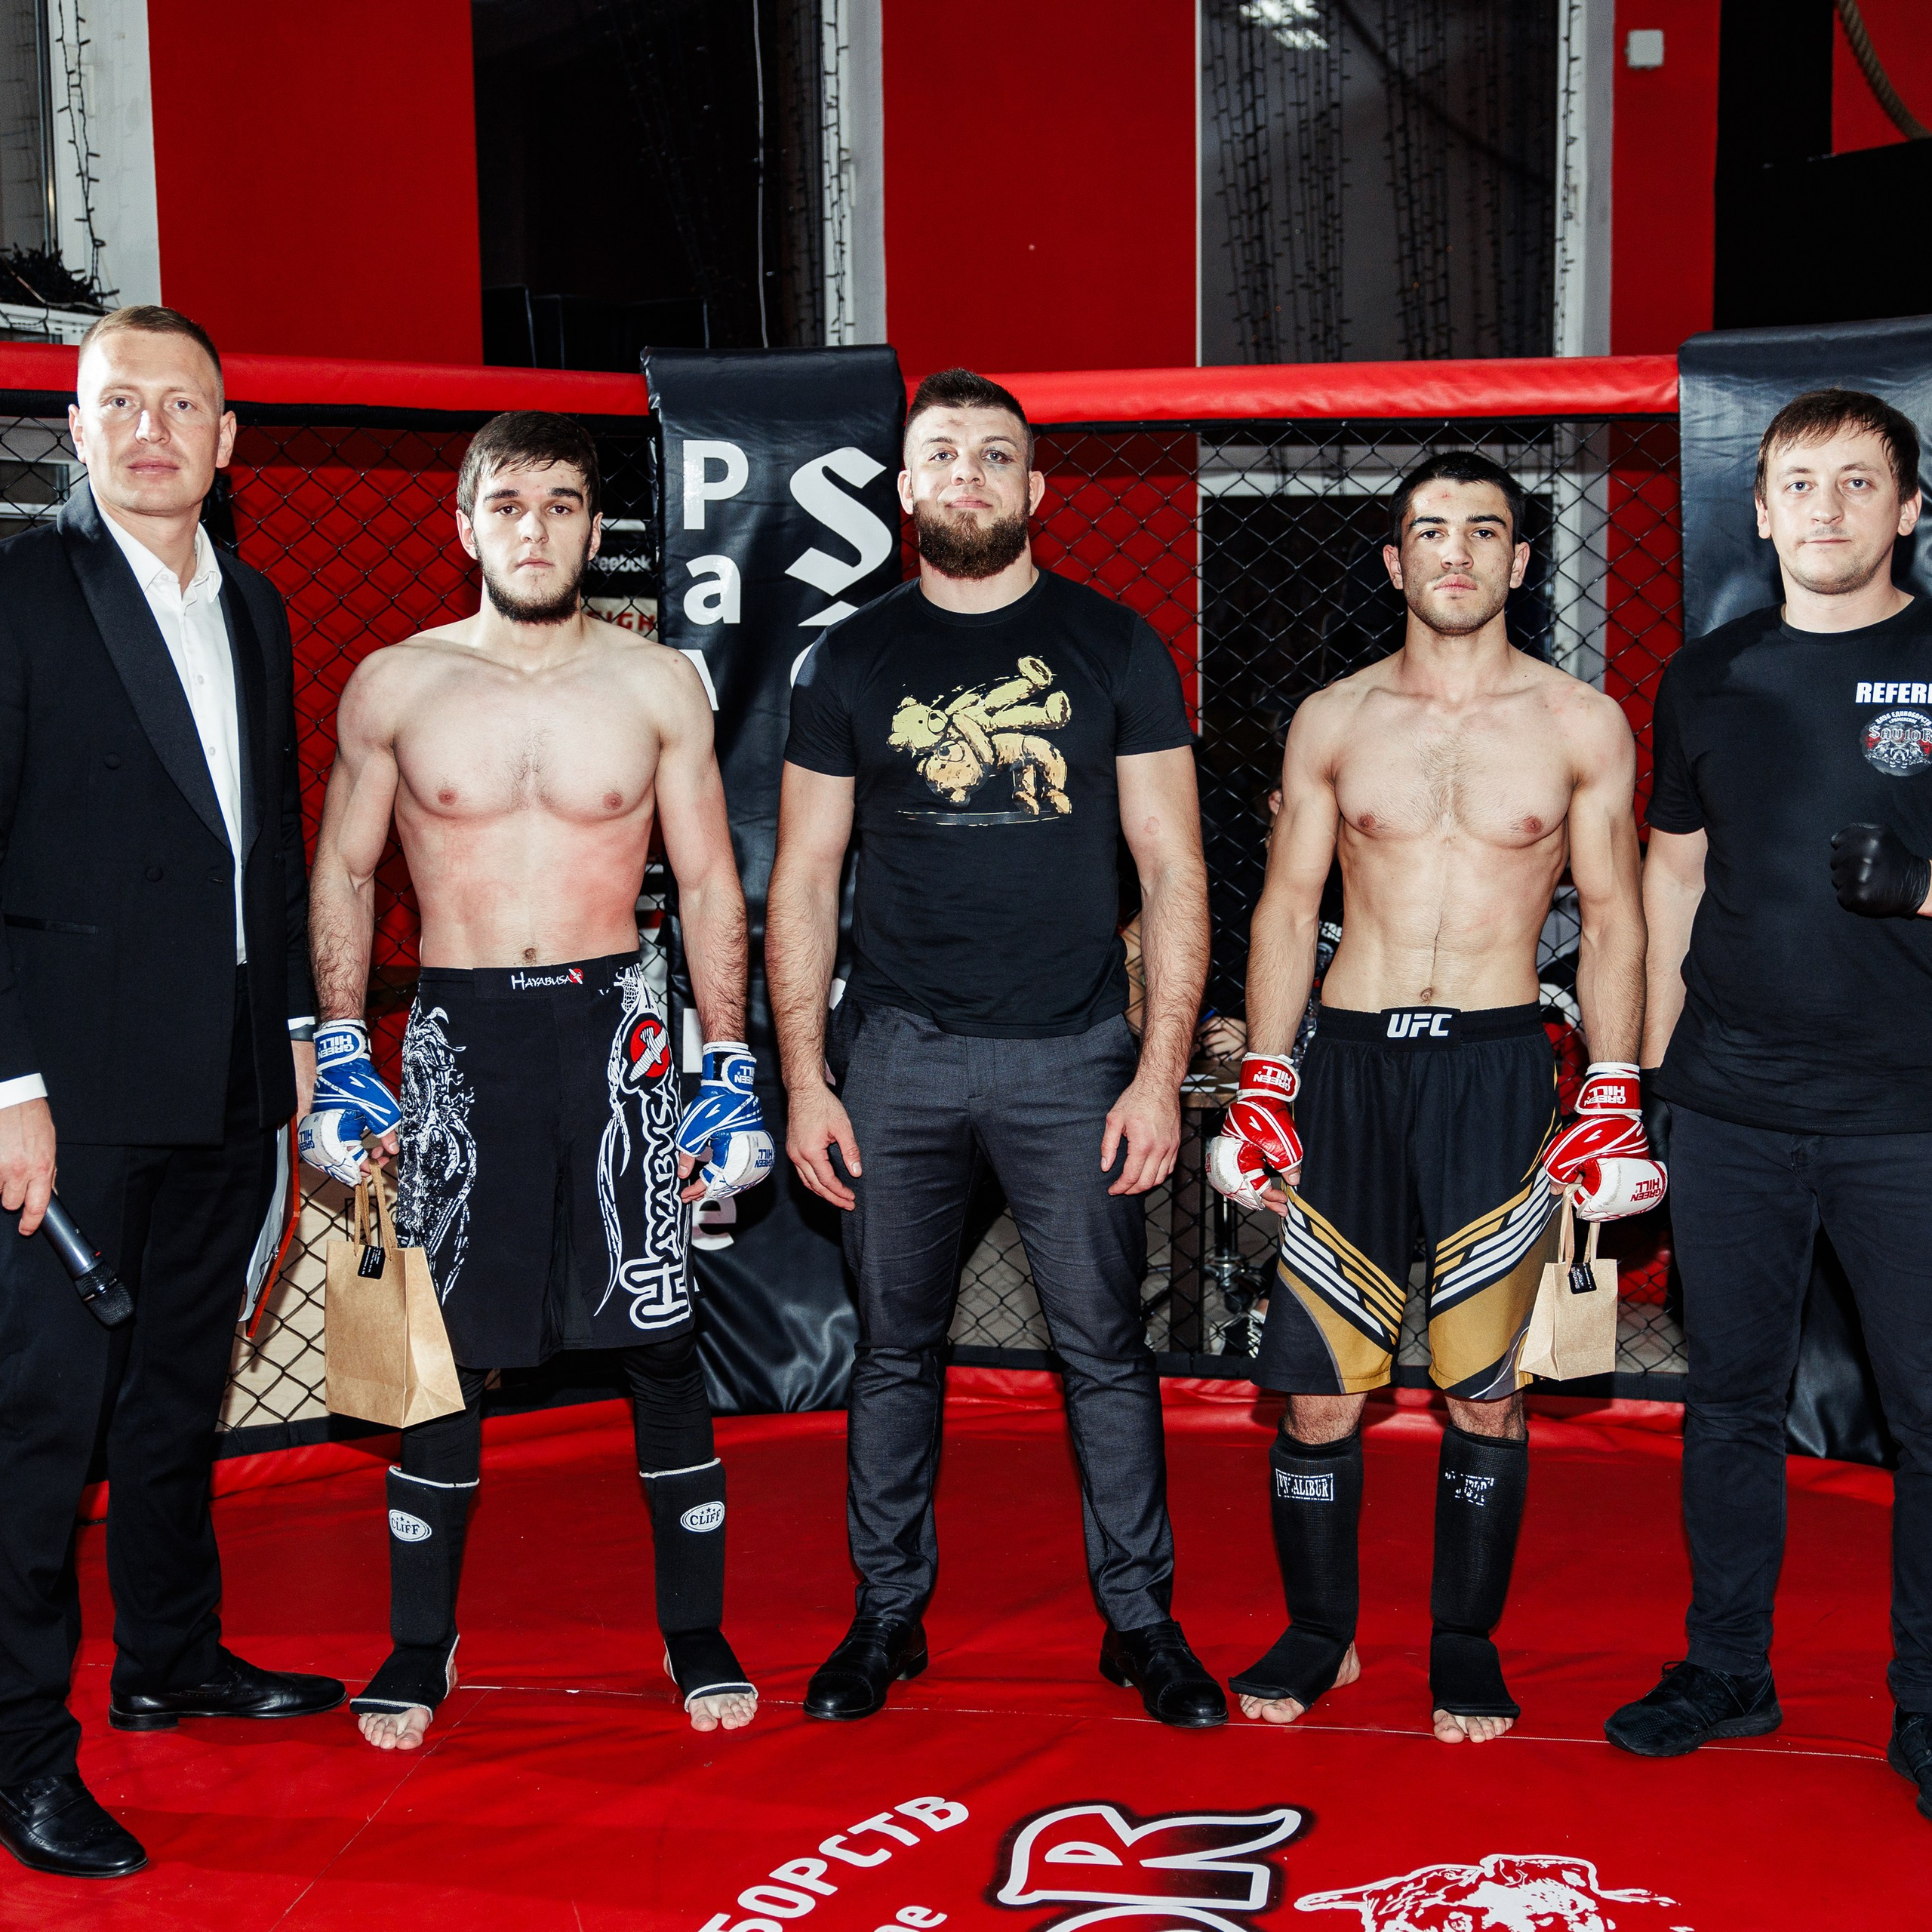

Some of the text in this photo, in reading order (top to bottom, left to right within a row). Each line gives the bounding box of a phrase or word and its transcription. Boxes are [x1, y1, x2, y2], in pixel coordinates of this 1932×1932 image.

[511, 971, 572, 990] HAYABUSA
[1387, 1014, 1453, 1038] UFC
[320, 1035, 352, 1050] HILL
[318, 1044, 355, 1060] GREEN
[734, 1074, 755, 1084] REEN
[740, 1066, 755, 1077] ILL
[1263, 1066, 1292, 1083] HILL
[1253, 1074, 1291, 1092] GREEN
[1589, 1085, 1626, 1095] HILL
[1584, 1094, 1626, 1106] GREEN
[299, 1128, 313, 1143] HILL
[758, 1149, 773, 1160] HILL
[1635, 1178, 1660, 1192] HILL
[629, 1072, 688, 1317] HAYABUSA
[1630, 1188, 1664, 1201] GREEN
[690, 1509, 721, 1526] CLIFF
[391, 1517, 420, 1535] CLIFF
